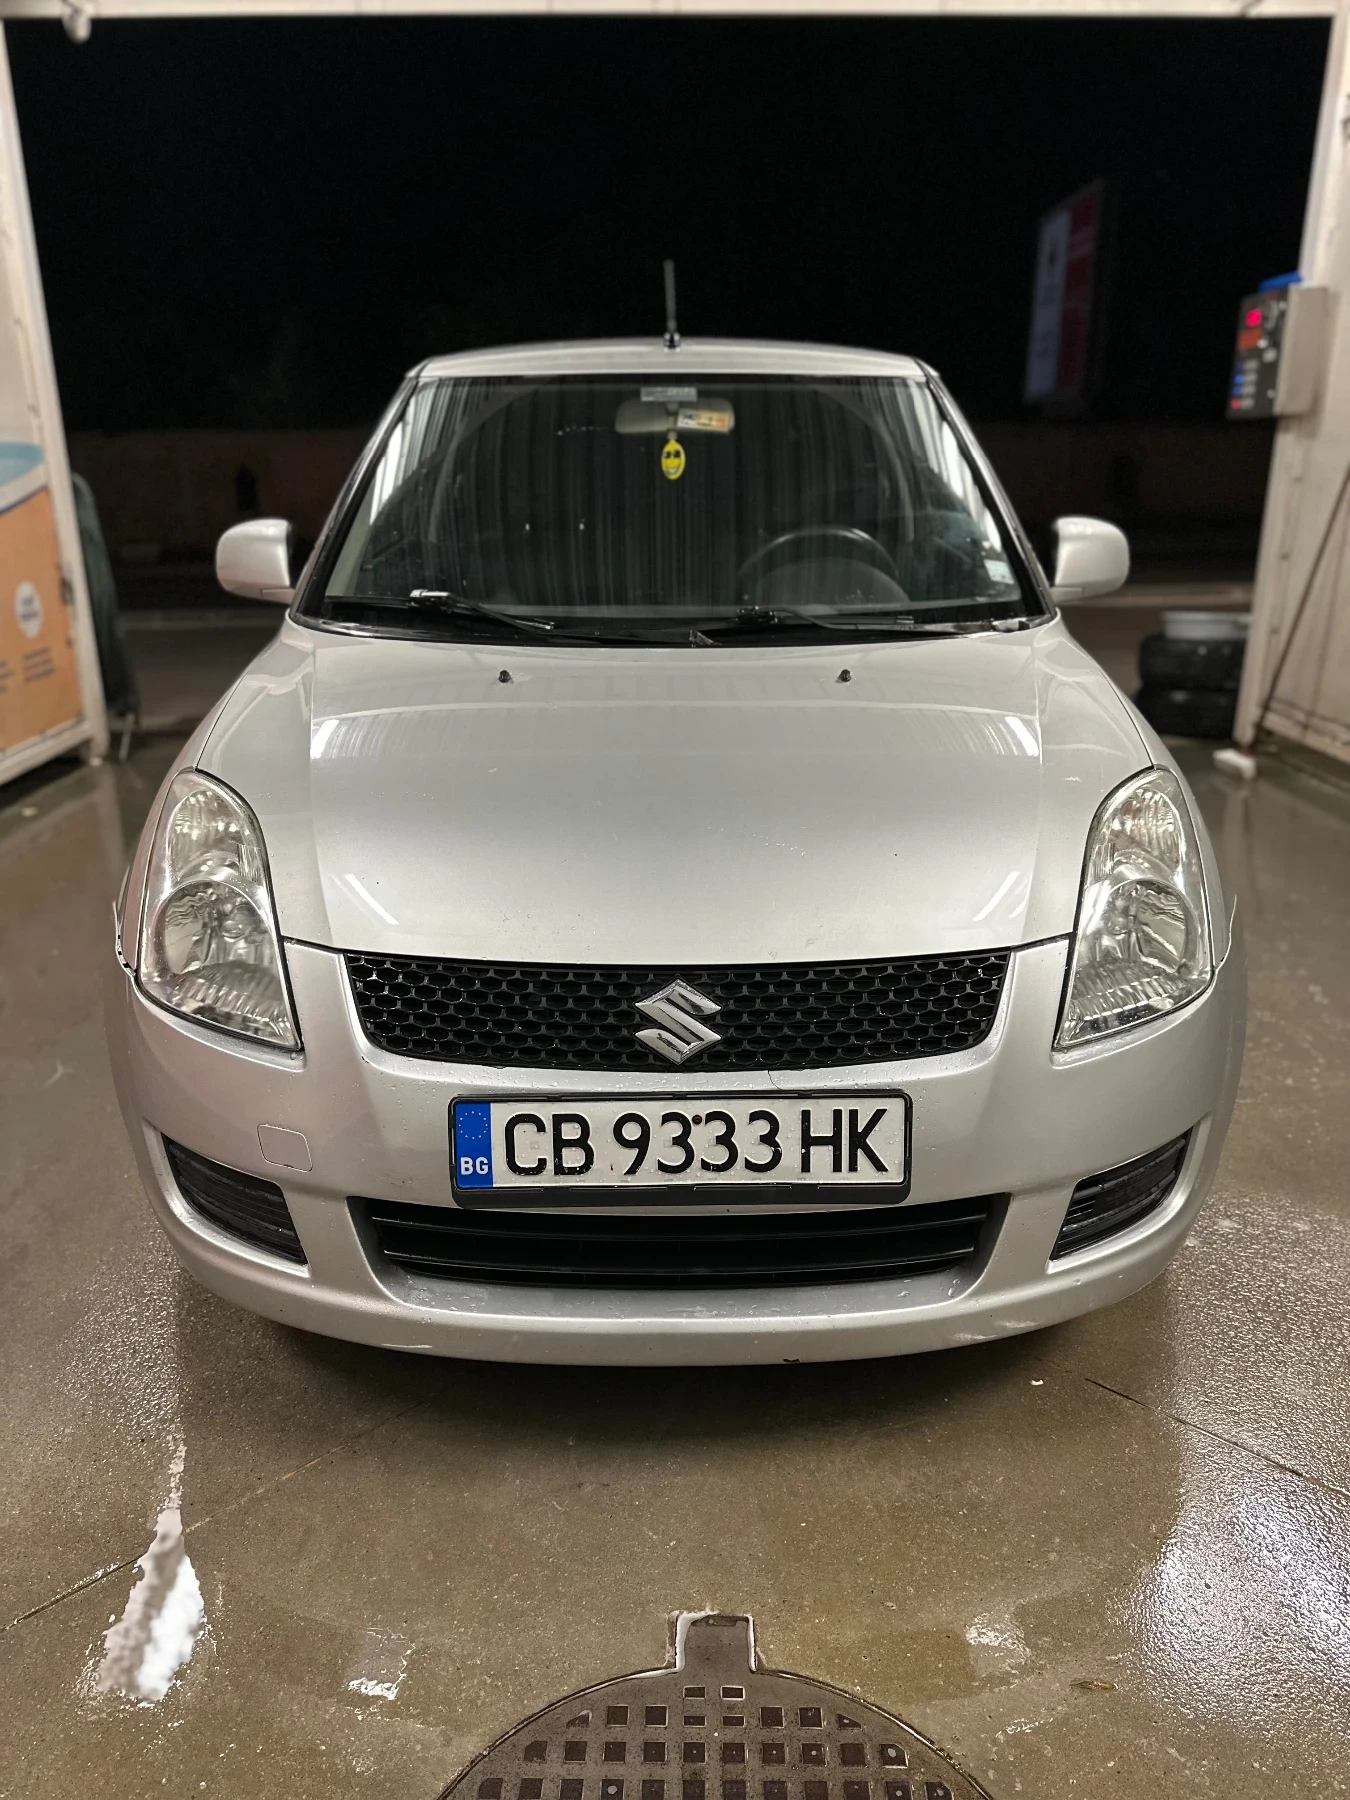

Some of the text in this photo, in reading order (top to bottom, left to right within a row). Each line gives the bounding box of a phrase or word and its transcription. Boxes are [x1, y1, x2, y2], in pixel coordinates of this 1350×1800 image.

[504, 1108, 889, 1175] CB 9333 HK
[460, 1157, 489, 1175] BG
